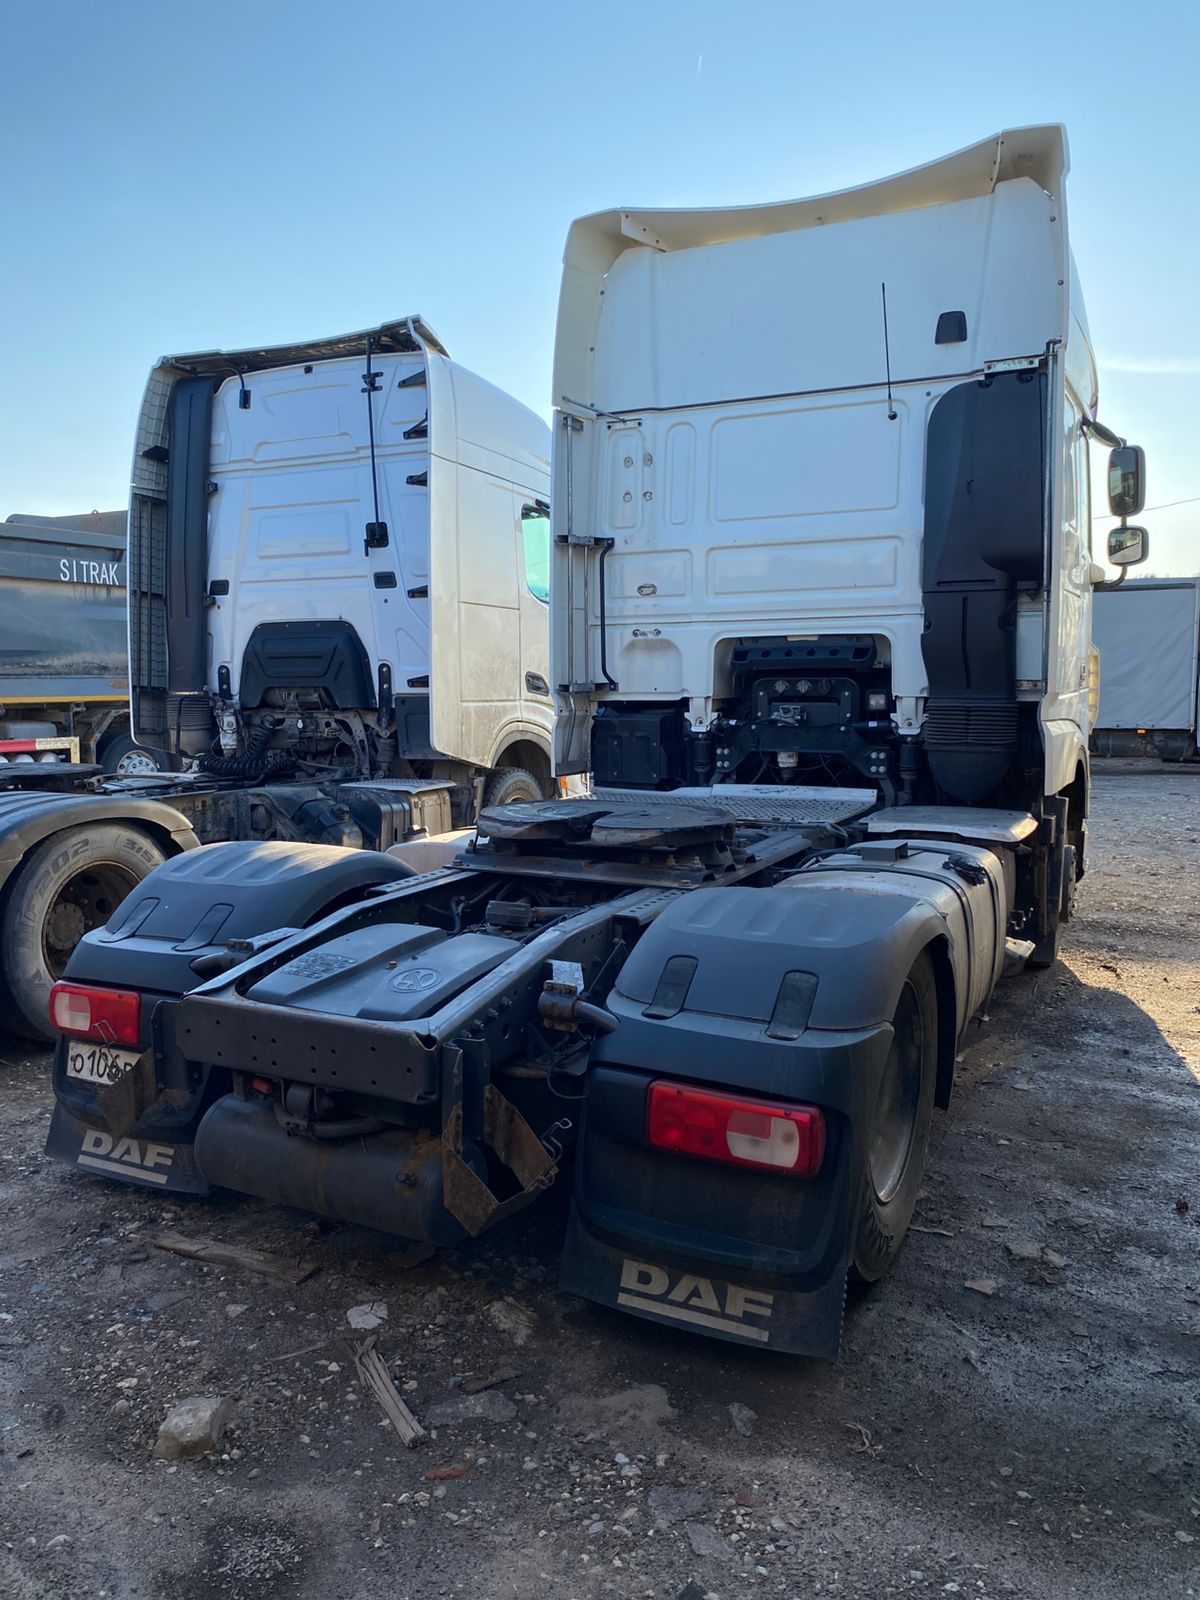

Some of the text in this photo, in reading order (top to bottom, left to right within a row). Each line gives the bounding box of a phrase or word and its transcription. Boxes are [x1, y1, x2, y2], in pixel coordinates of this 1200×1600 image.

[60, 558, 119, 586] SITRAK
[81, 1128, 175, 1168] DAF
[620, 1258, 774, 1318] DAF
